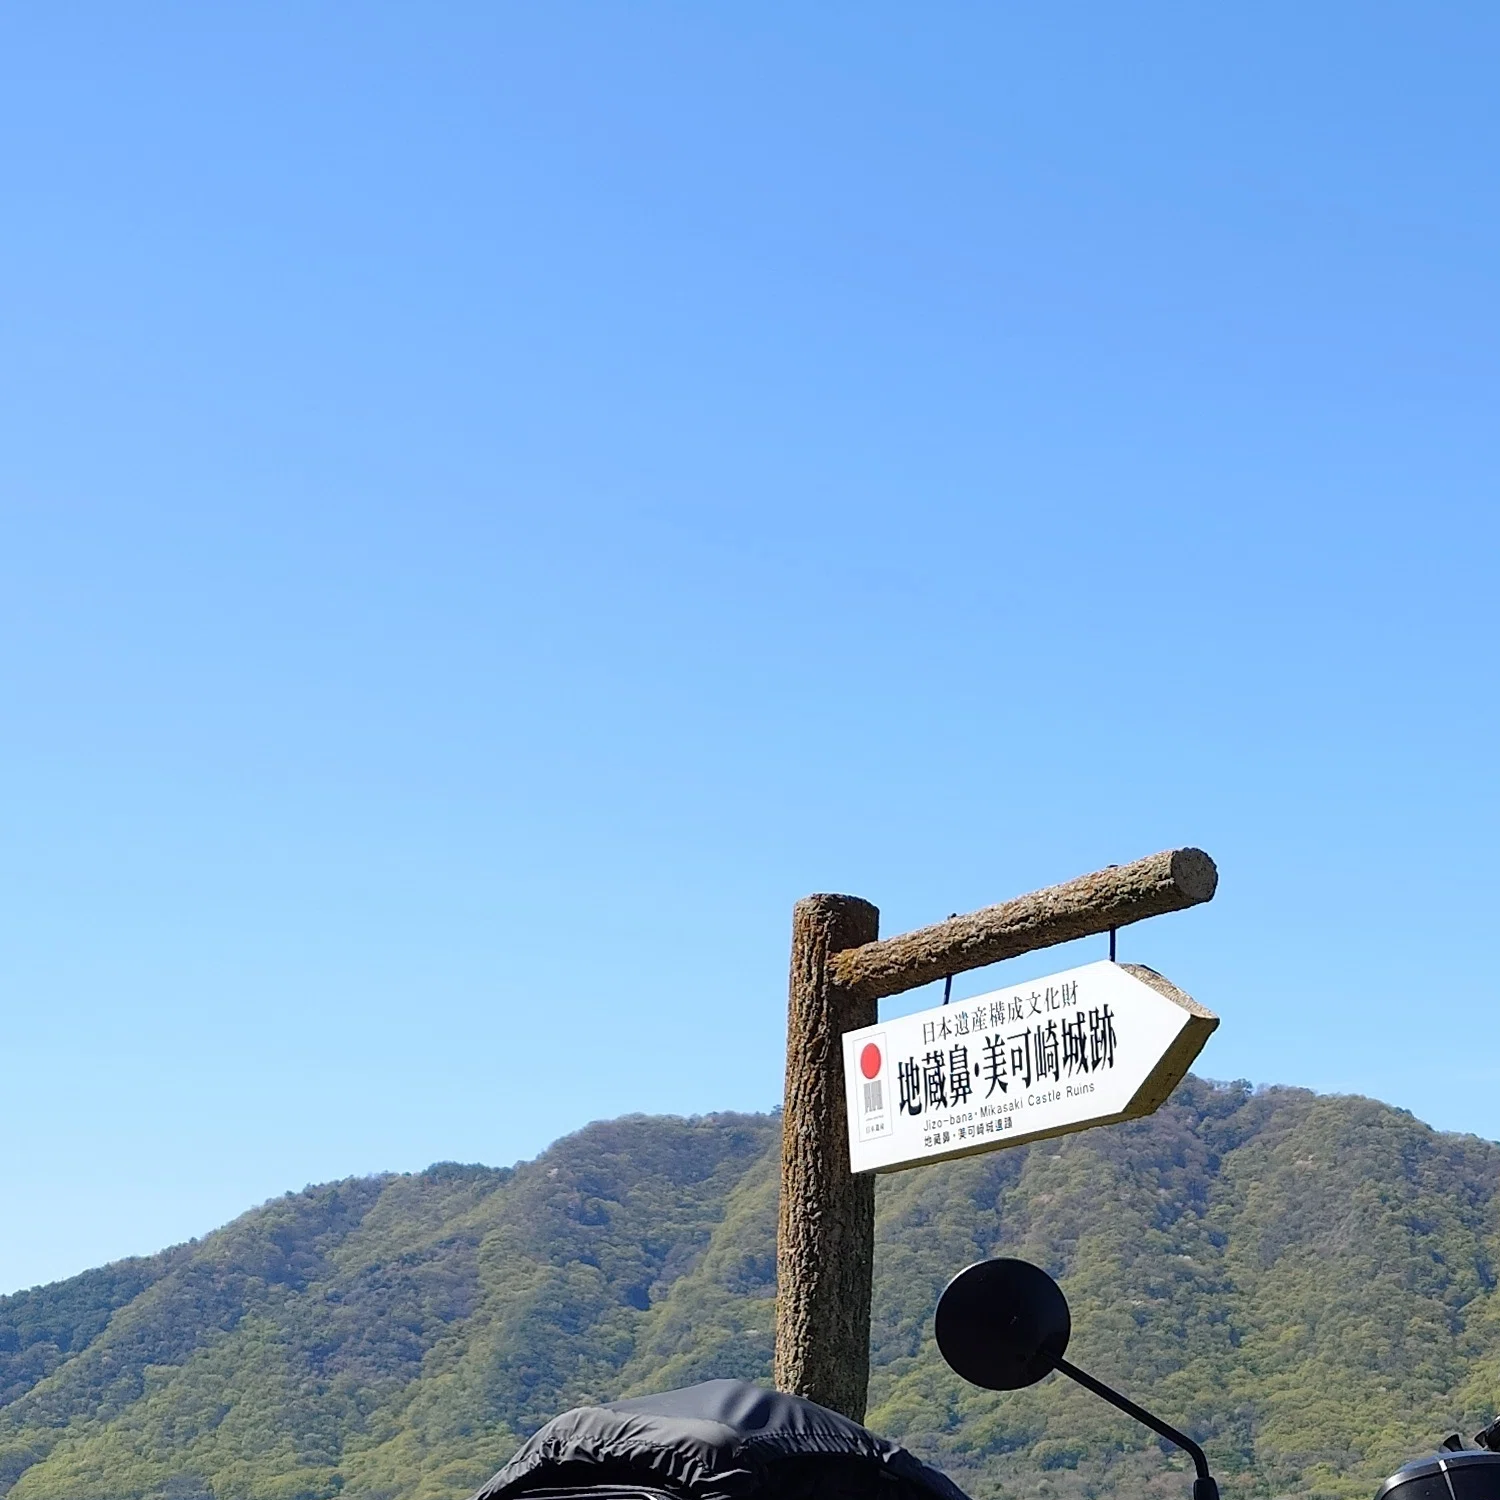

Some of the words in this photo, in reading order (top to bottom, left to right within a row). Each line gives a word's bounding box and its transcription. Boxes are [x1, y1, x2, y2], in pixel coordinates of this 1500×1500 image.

[922, 980, 1079, 1046] 日本遺産構成文化財
[1027, 1090, 1061, 1106] Castle
[1066, 1082, 1095, 1098] Ruins
